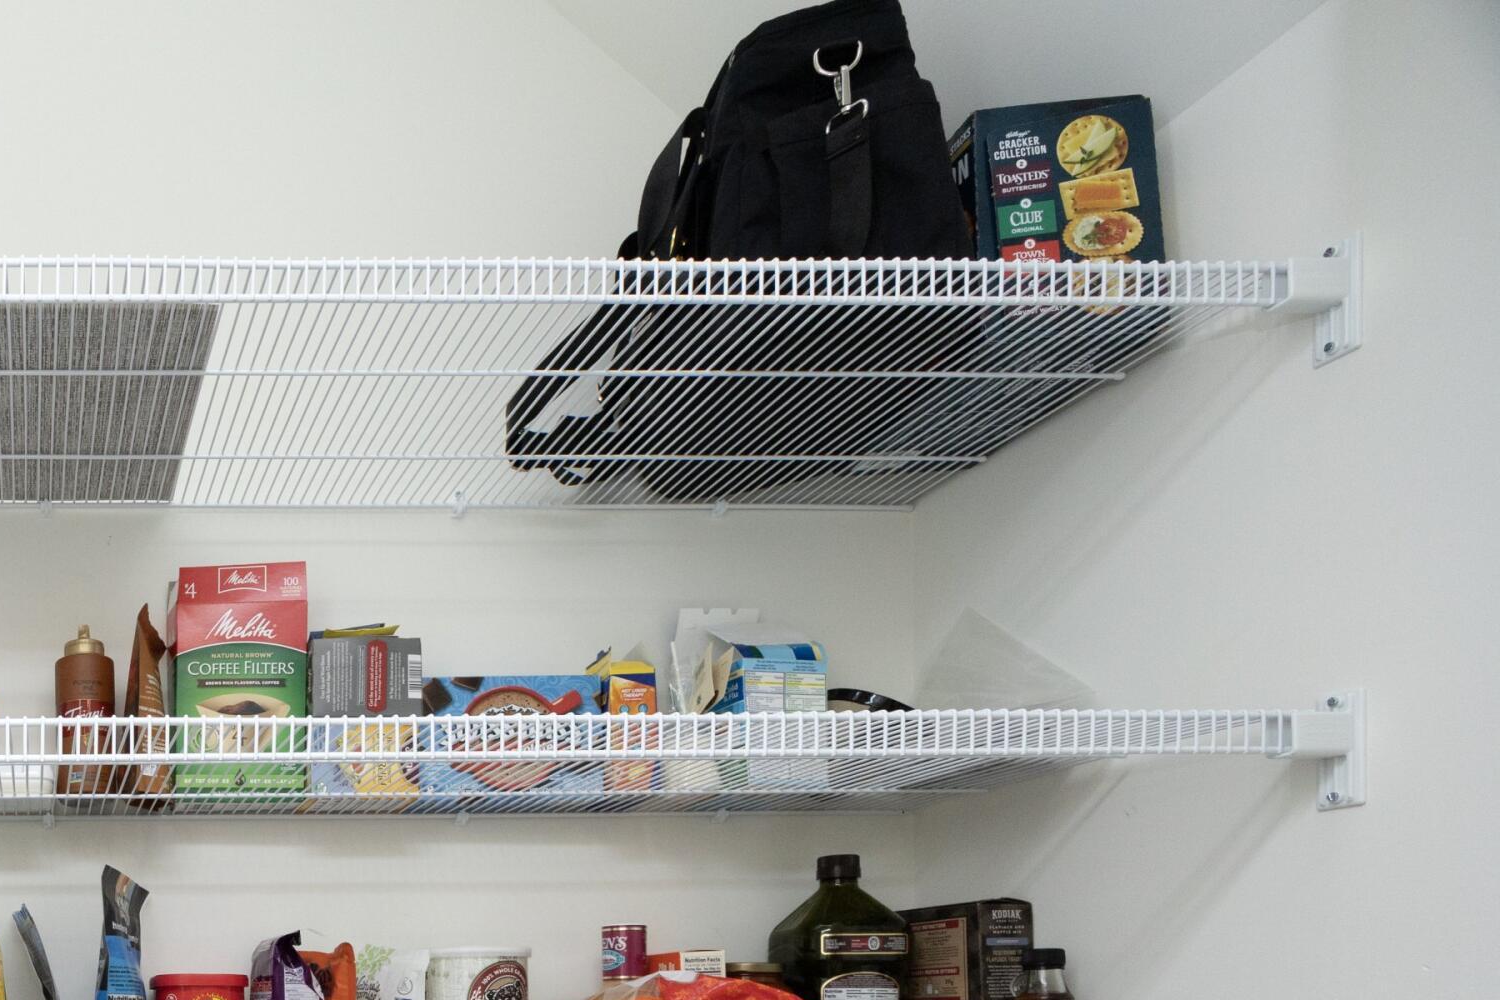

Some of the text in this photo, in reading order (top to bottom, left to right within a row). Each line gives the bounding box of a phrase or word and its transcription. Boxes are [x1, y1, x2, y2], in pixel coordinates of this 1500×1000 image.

[999, 136, 1040, 149] CRACKER
[994, 145, 1047, 160] COLLECTION
[996, 170, 1048, 185] TOASTEDS
[1002, 183, 1047, 193] BUTTERCRISP
[1010, 211, 1043, 226] CLUB
[1011, 226, 1044, 234] ORIGINAL
[283, 576, 299, 586] 100
[205, 608, 277, 640] Melitta
[187, 660, 295, 676] COFFEE FILTERS
[992, 909, 1023, 920] KODIAK
